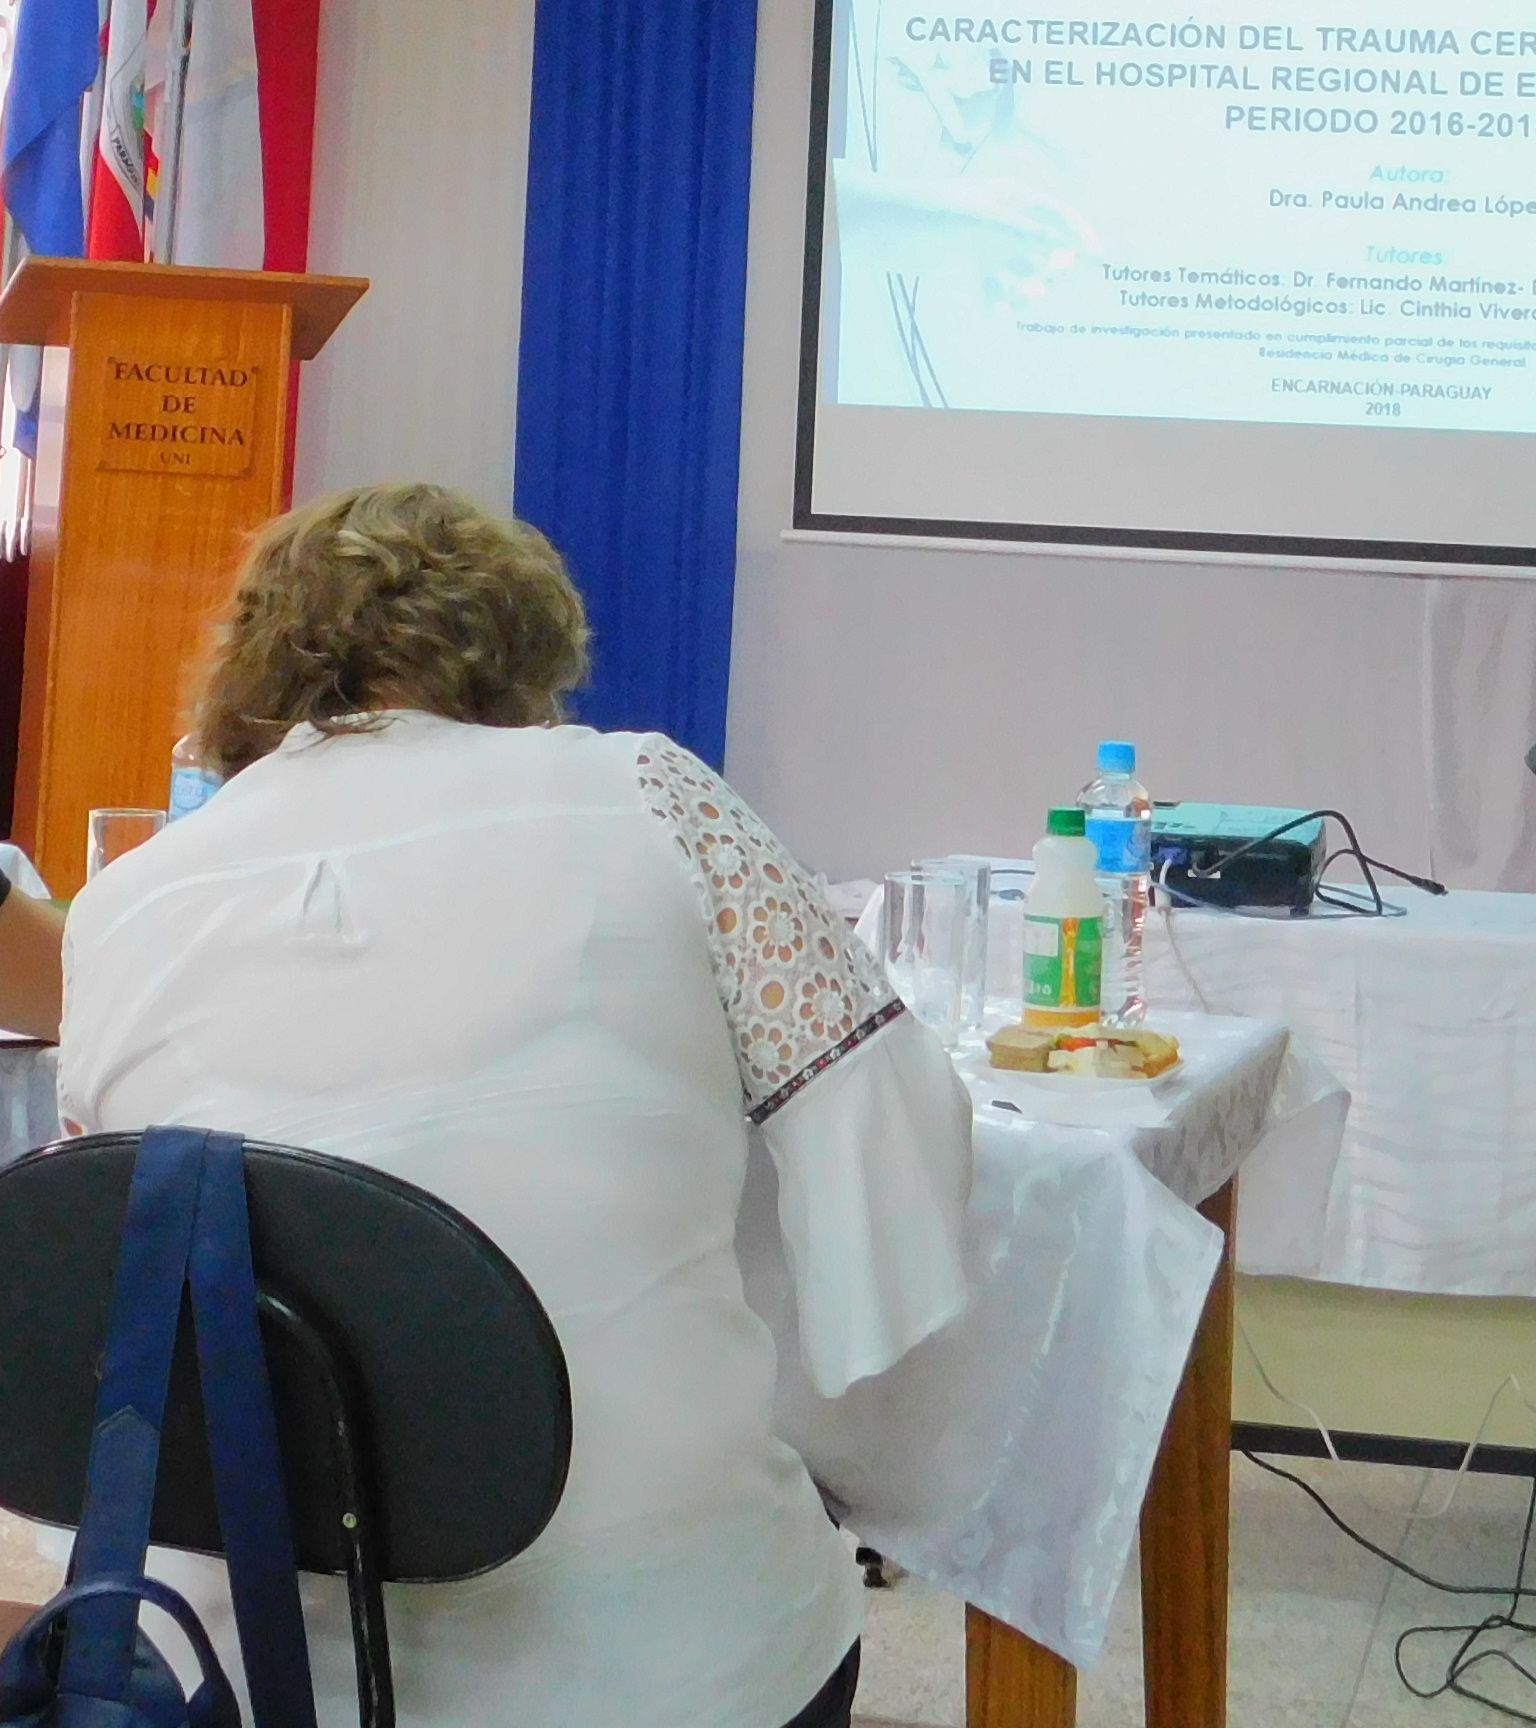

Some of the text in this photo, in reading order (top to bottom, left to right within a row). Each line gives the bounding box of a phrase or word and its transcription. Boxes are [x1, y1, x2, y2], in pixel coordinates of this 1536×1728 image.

[905, 16, 1226, 50] CARACTERIZACIÓN
[1238, 25, 1304, 51] DEL
[1316, 27, 1460, 56] TRAUMA
[989, 58, 1032, 85] EN
[1044, 60, 1084, 86] EL
[1096, 61, 1260, 91] HOSPITAL
[1271, 66, 1448, 96] REGIONAL
[1459, 70, 1505, 97] DE
[1225, 105, 1379, 134] PERIODO
[1269, 188, 1313, 208] Dra.
[1322, 190, 1385, 210] Paula
[1392, 192, 1477, 214] Andrea
[1102, 263, 1172, 283] Tutores
[1326, 272, 1423, 292] Fernando
[1428, 274, 1525, 295] Martínez-
[1120, 289, 1189, 309] Tutores
[1195, 292, 1353, 317] Metodológicos:
[1399, 299, 1472, 320] Cinthia
[1016, 320, 1065, 334] Trabajo
[1069, 323, 1087, 335] de
[1091, 324, 1180, 339] investigación
[1184, 327, 1261, 342] presentado
[1265, 332, 1282, 342] en
[1287, 332, 1380, 347] cumplimiento
[1384, 335, 1433, 349] parcial
[1437, 336, 1455, 349] de
[1459, 337, 1478, 349] los
[1259, 346, 1333, 361] Residencia
[1393, 351, 1411, 364] de
[1469, 354, 1527, 368] General
[113, 361, 248, 388] FACULTAD
[161, 393, 197, 414] DE
[1364, 401, 1402, 417] 2018
[107, 422, 245, 446] MEDICINA
[159, 451, 191, 466] UNI
